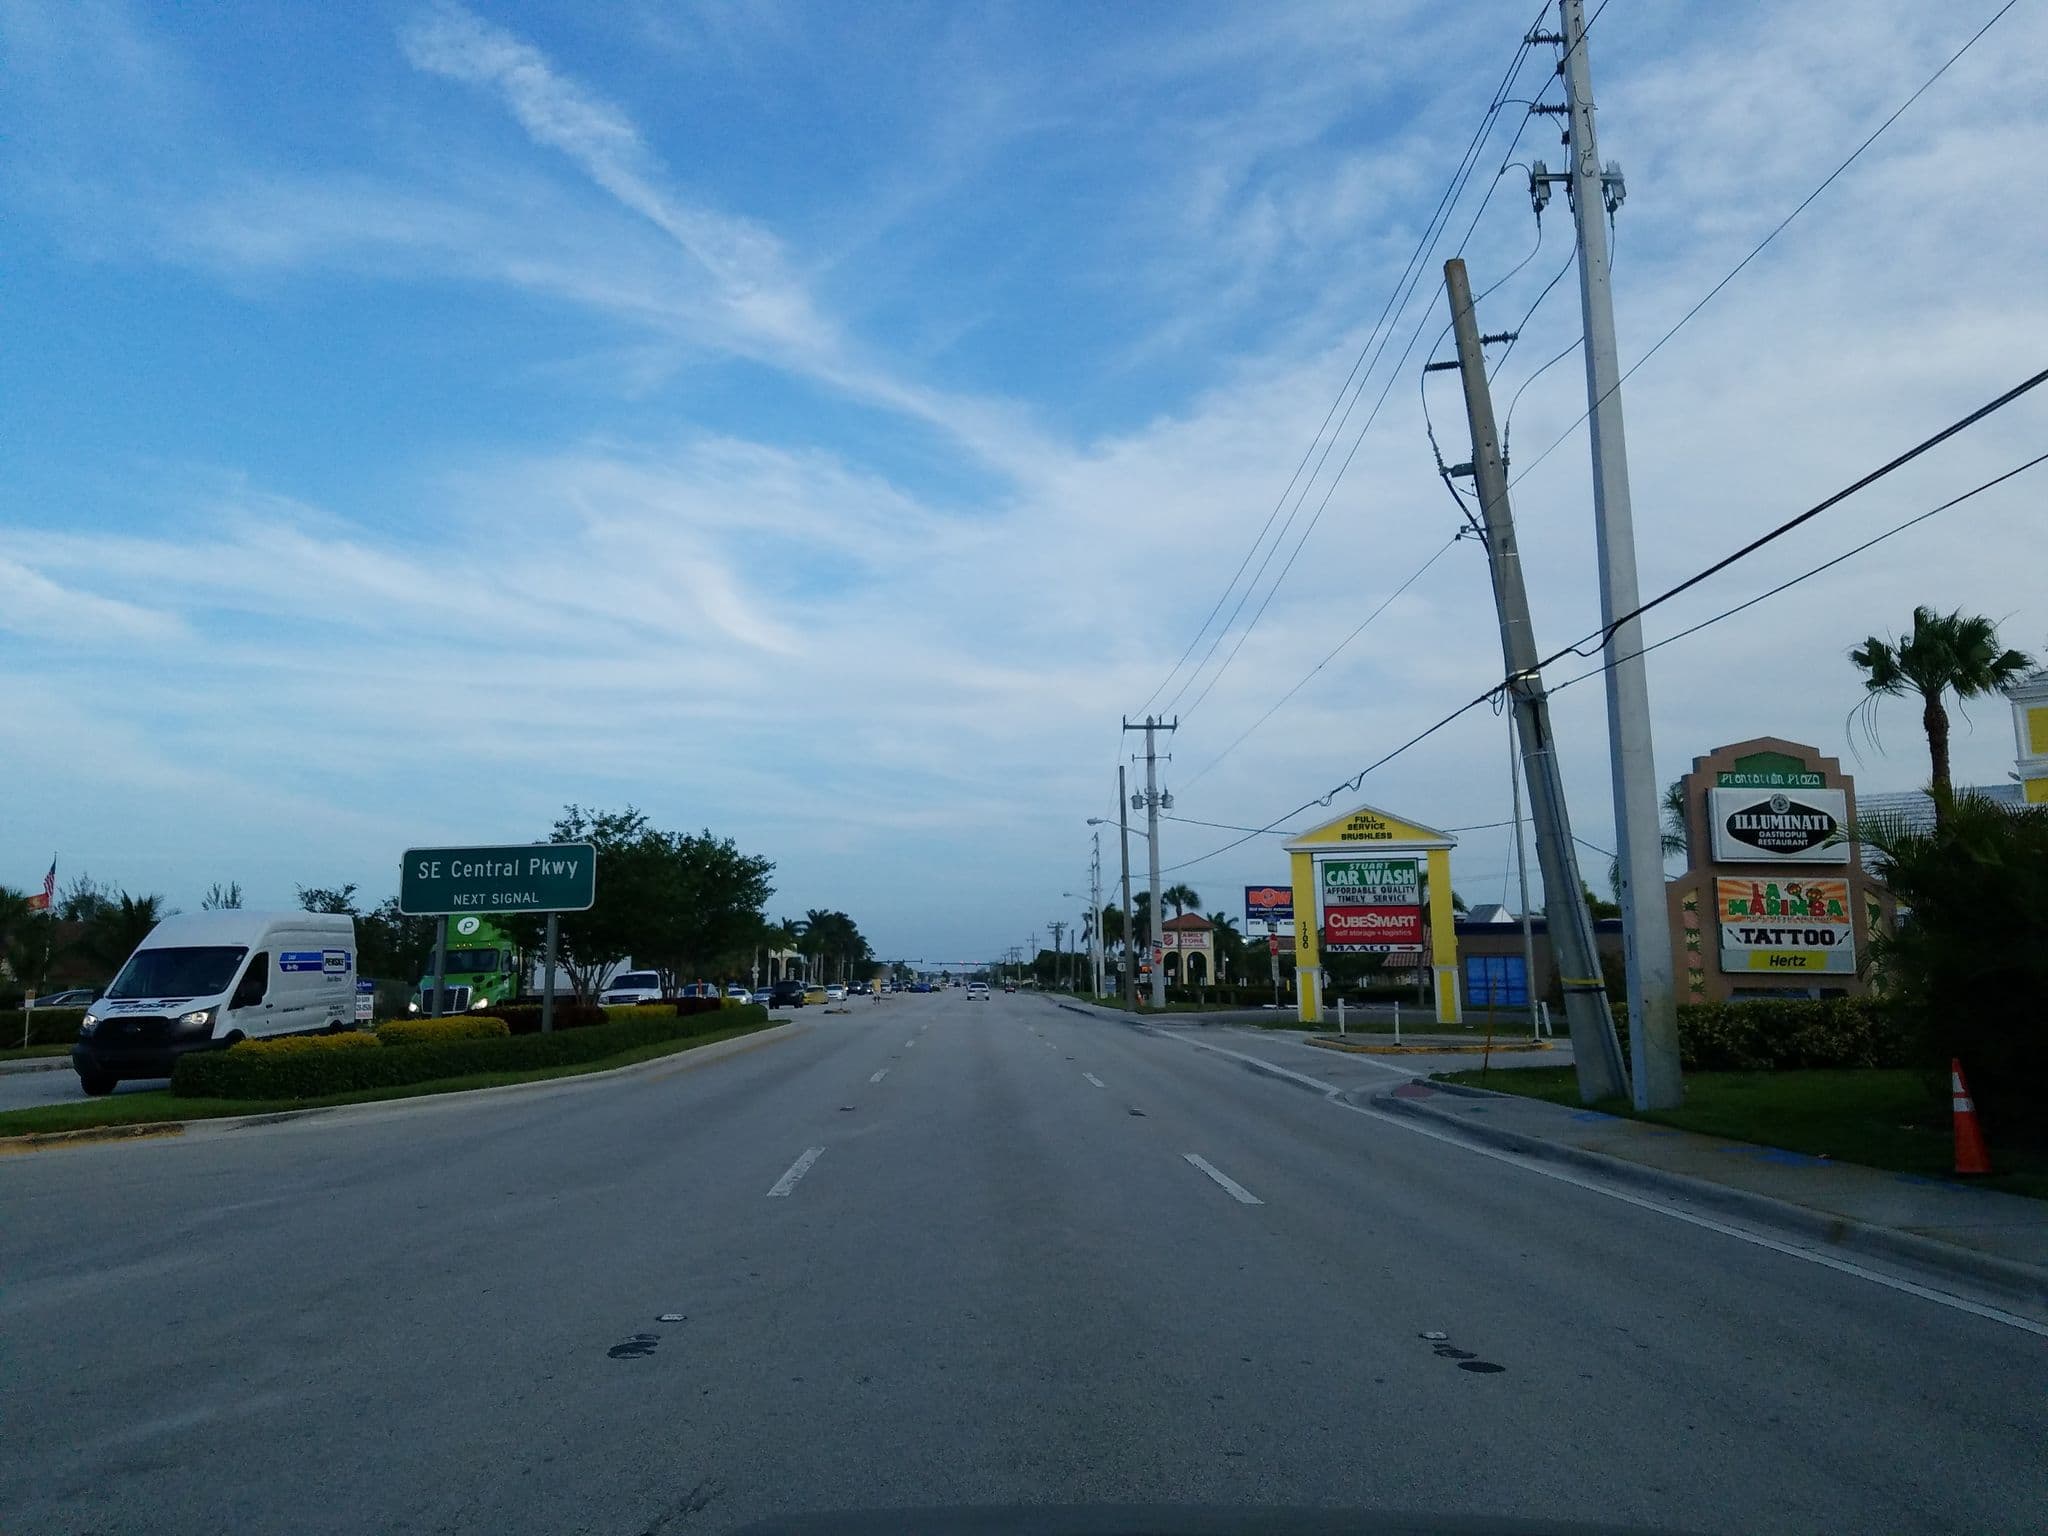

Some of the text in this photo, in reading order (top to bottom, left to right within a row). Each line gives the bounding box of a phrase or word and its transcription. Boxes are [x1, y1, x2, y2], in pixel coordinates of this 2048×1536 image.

[1354, 815, 1377, 823] FULL
[1734, 814, 1830, 830] ILLUMINATI
[1347, 823, 1386, 831] SERVICE
[1341, 832, 1393, 840] BRUSHLESS
[418, 858, 579, 879] SE Central Pkwy
[1348, 862, 1391, 870] STUART
[1326, 869, 1415, 885] CAR WASH
[1326, 886, 1415, 895] AFFORDABLE QUALITY
[453, 892, 540, 905] NEXT SIGNAL
[1337, 895, 1365, 903] TIMELY
[1739, 928, 1835, 946] TATTOO
[1769, 954, 1807, 967] Hertz
